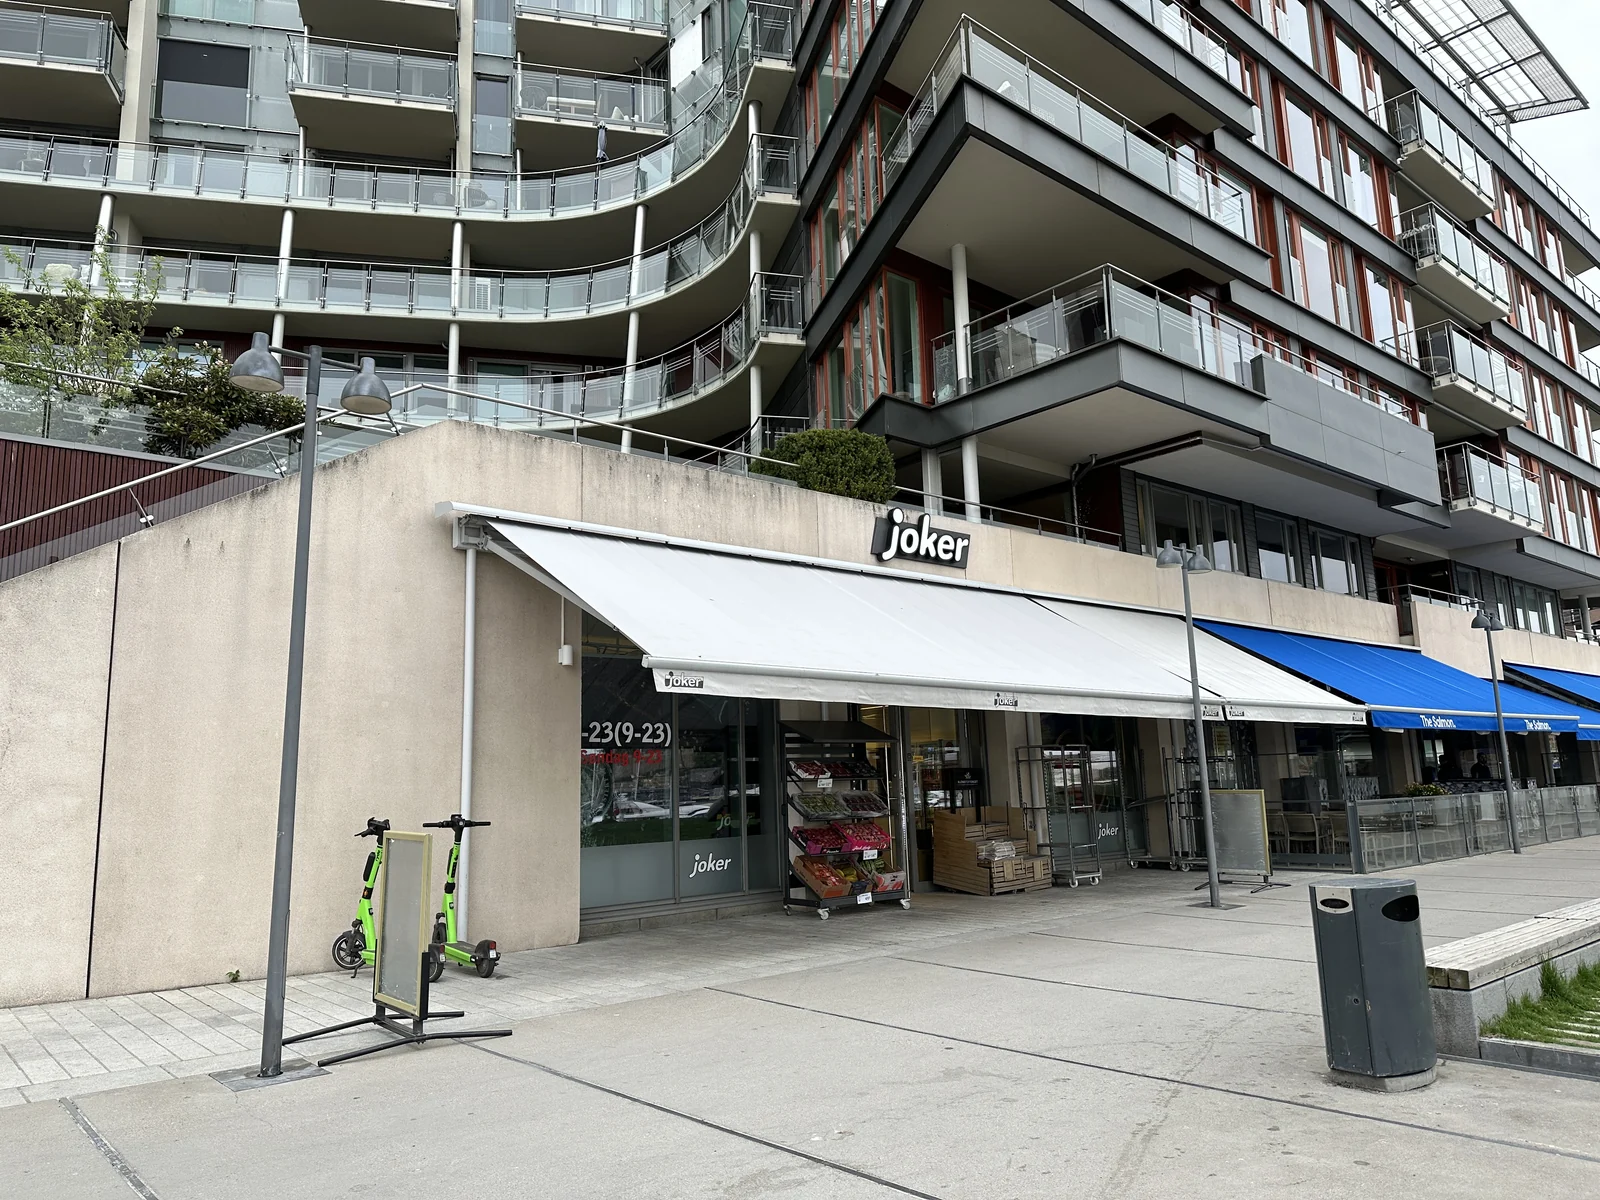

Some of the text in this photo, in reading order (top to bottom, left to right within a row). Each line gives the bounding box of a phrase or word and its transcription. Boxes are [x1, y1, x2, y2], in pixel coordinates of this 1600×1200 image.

[880, 507, 969, 562] joker
[665, 671, 704, 689] joker
[994, 692, 1018, 708] joker
[1420, 714, 1433, 728] The
[633, 749, 663, 765] 9-23
[1097, 822, 1119, 840] joker
[689, 852, 732, 878] joker
